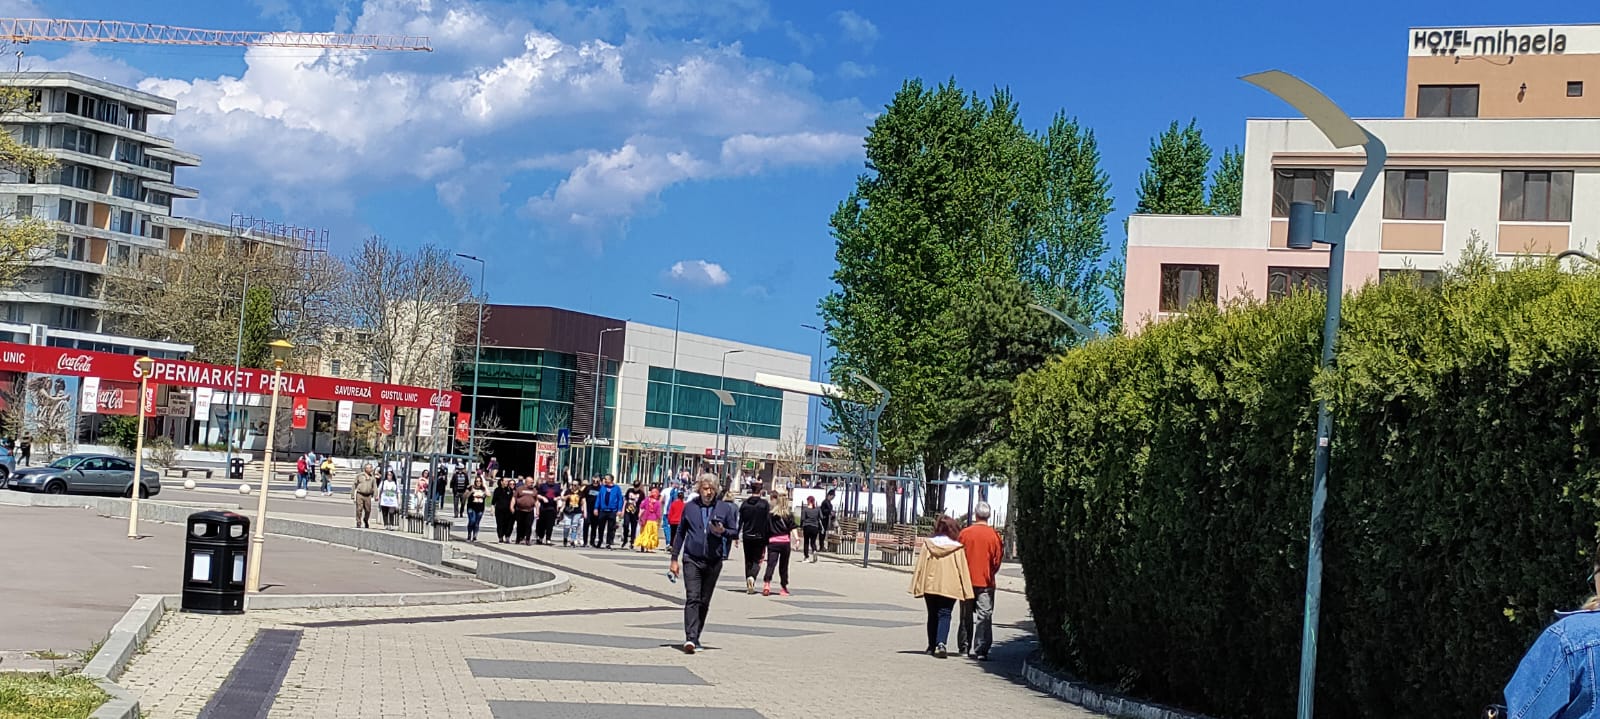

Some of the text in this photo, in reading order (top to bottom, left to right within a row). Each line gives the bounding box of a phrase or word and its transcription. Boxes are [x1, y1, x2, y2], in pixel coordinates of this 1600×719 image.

[1414, 28, 1567, 54] HOTEL mihaela
[3, 351, 26, 364] UNIC
[132, 361, 306, 394] SUPERMARKET PERLA
[380, 389, 418, 402] GUSTUL UNIC
